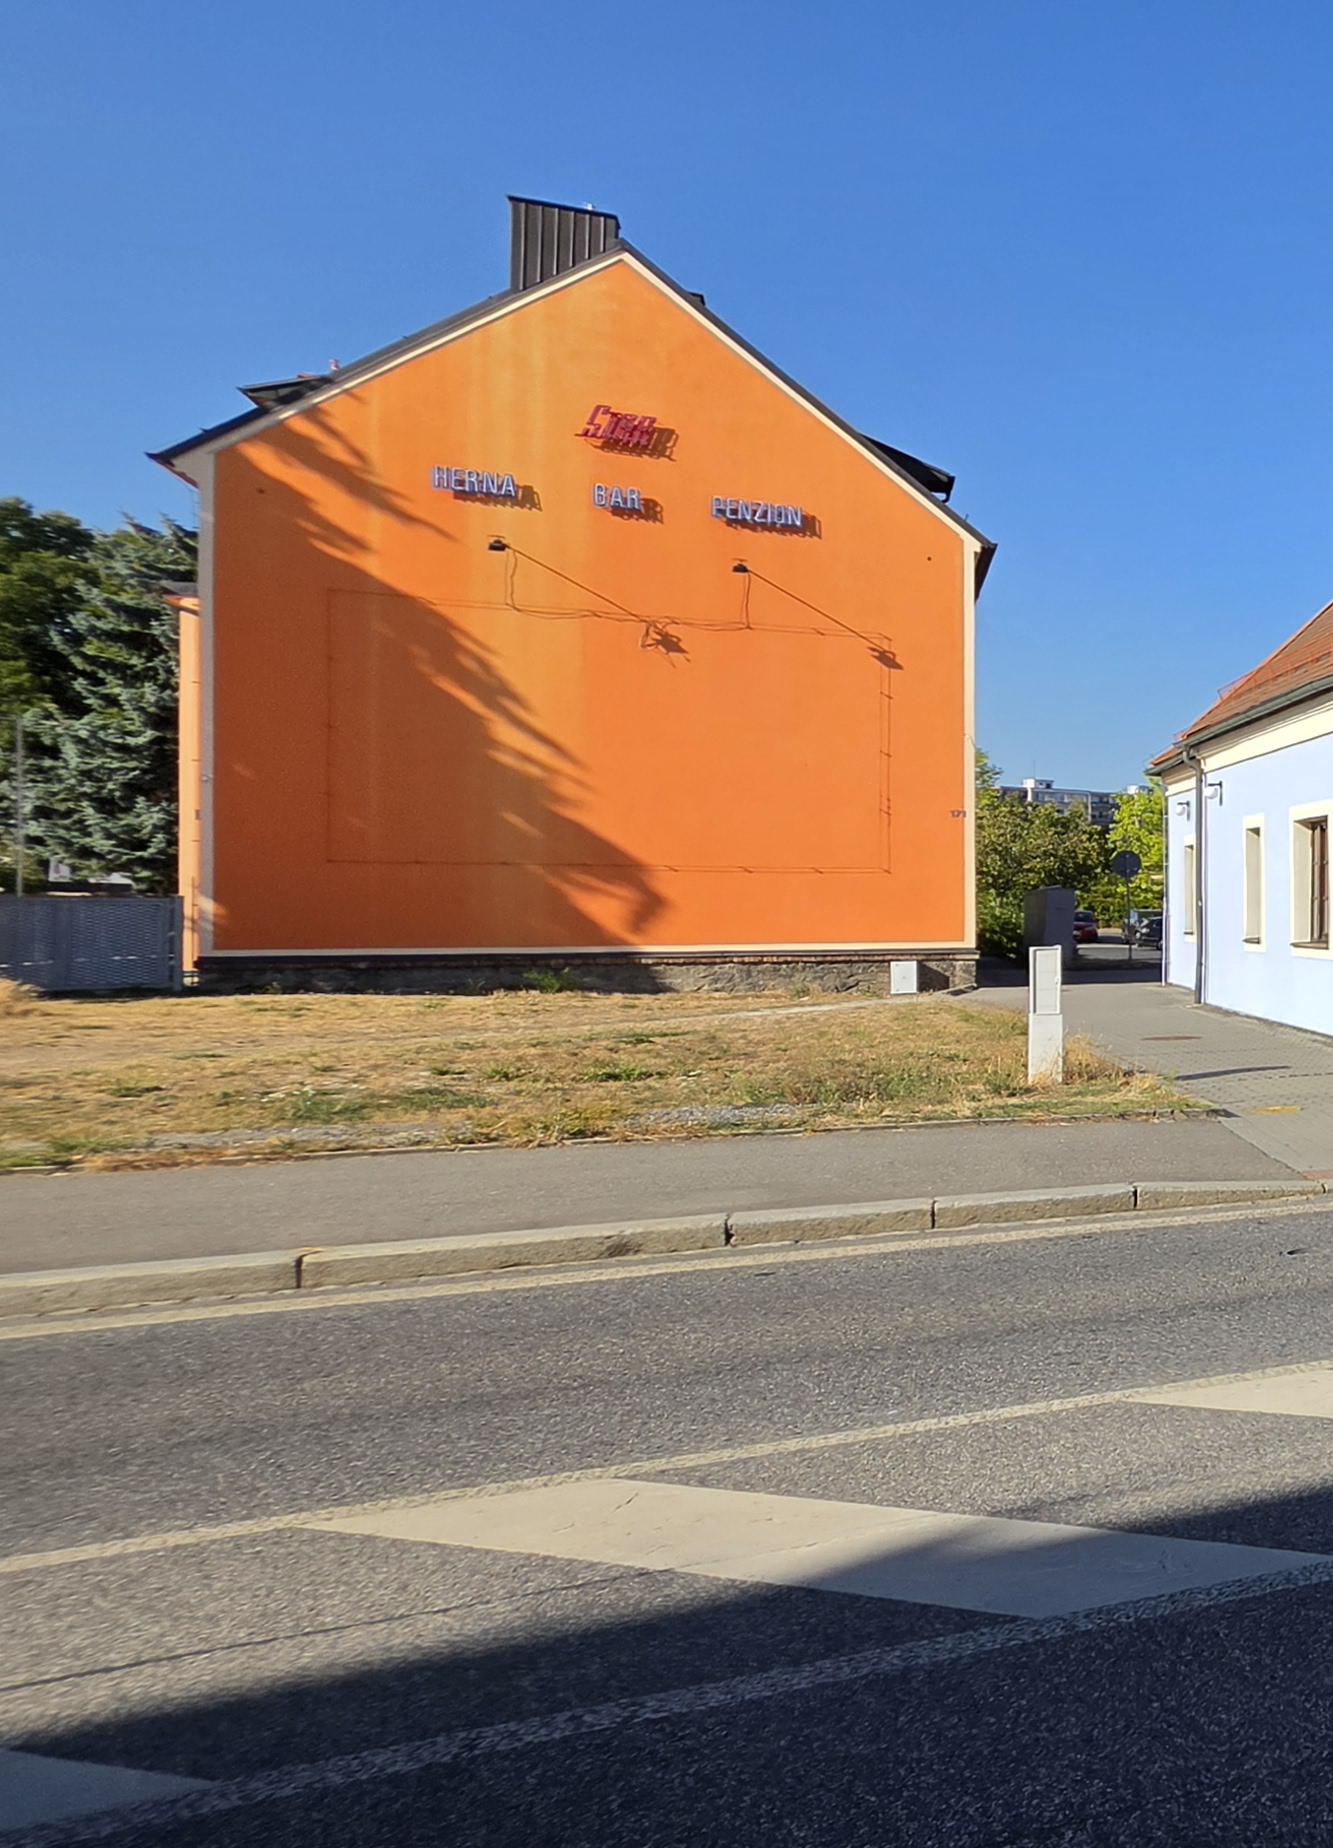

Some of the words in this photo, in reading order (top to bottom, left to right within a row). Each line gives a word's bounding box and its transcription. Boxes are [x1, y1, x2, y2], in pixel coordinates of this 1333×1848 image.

[432, 466, 518, 498] HERNA
[593, 483, 642, 511] BAR
[711, 496, 803, 528] PENZION
